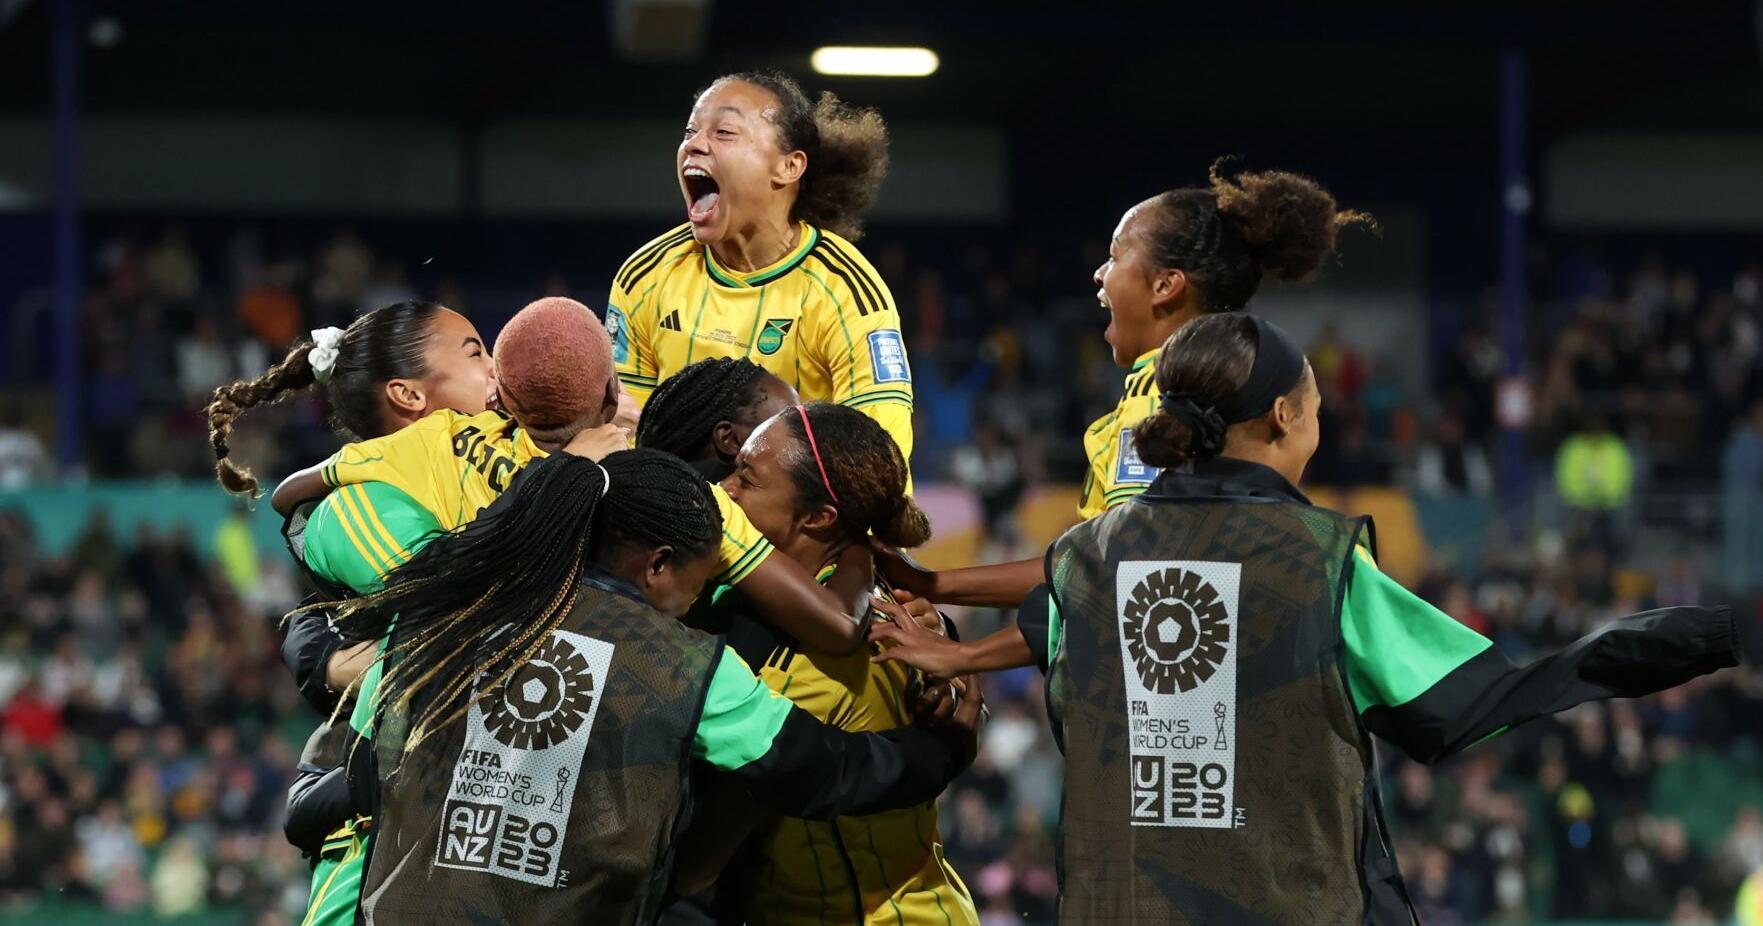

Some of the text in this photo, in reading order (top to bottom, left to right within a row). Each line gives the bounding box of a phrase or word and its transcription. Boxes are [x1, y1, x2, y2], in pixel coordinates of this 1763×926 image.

[1133, 719, 1191, 733] MEN'S
[1133, 735, 1208, 750] RLD CUP
[461, 749, 502, 768] FIFA
[458, 766, 533, 789] WOMEN'S
[1133, 760, 1160, 789] U
[1171, 762, 1228, 791] 20
[455, 780, 545, 807] WORLD CUP
[1134, 790, 1159, 818] Z
[1171, 791, 1226, 819] 23
[449, 806, 497, 835] AU
[502, 813, 559, 849] 20
[444, 833, 490, 864] NZ
[497, 841, 552, 878] 23
